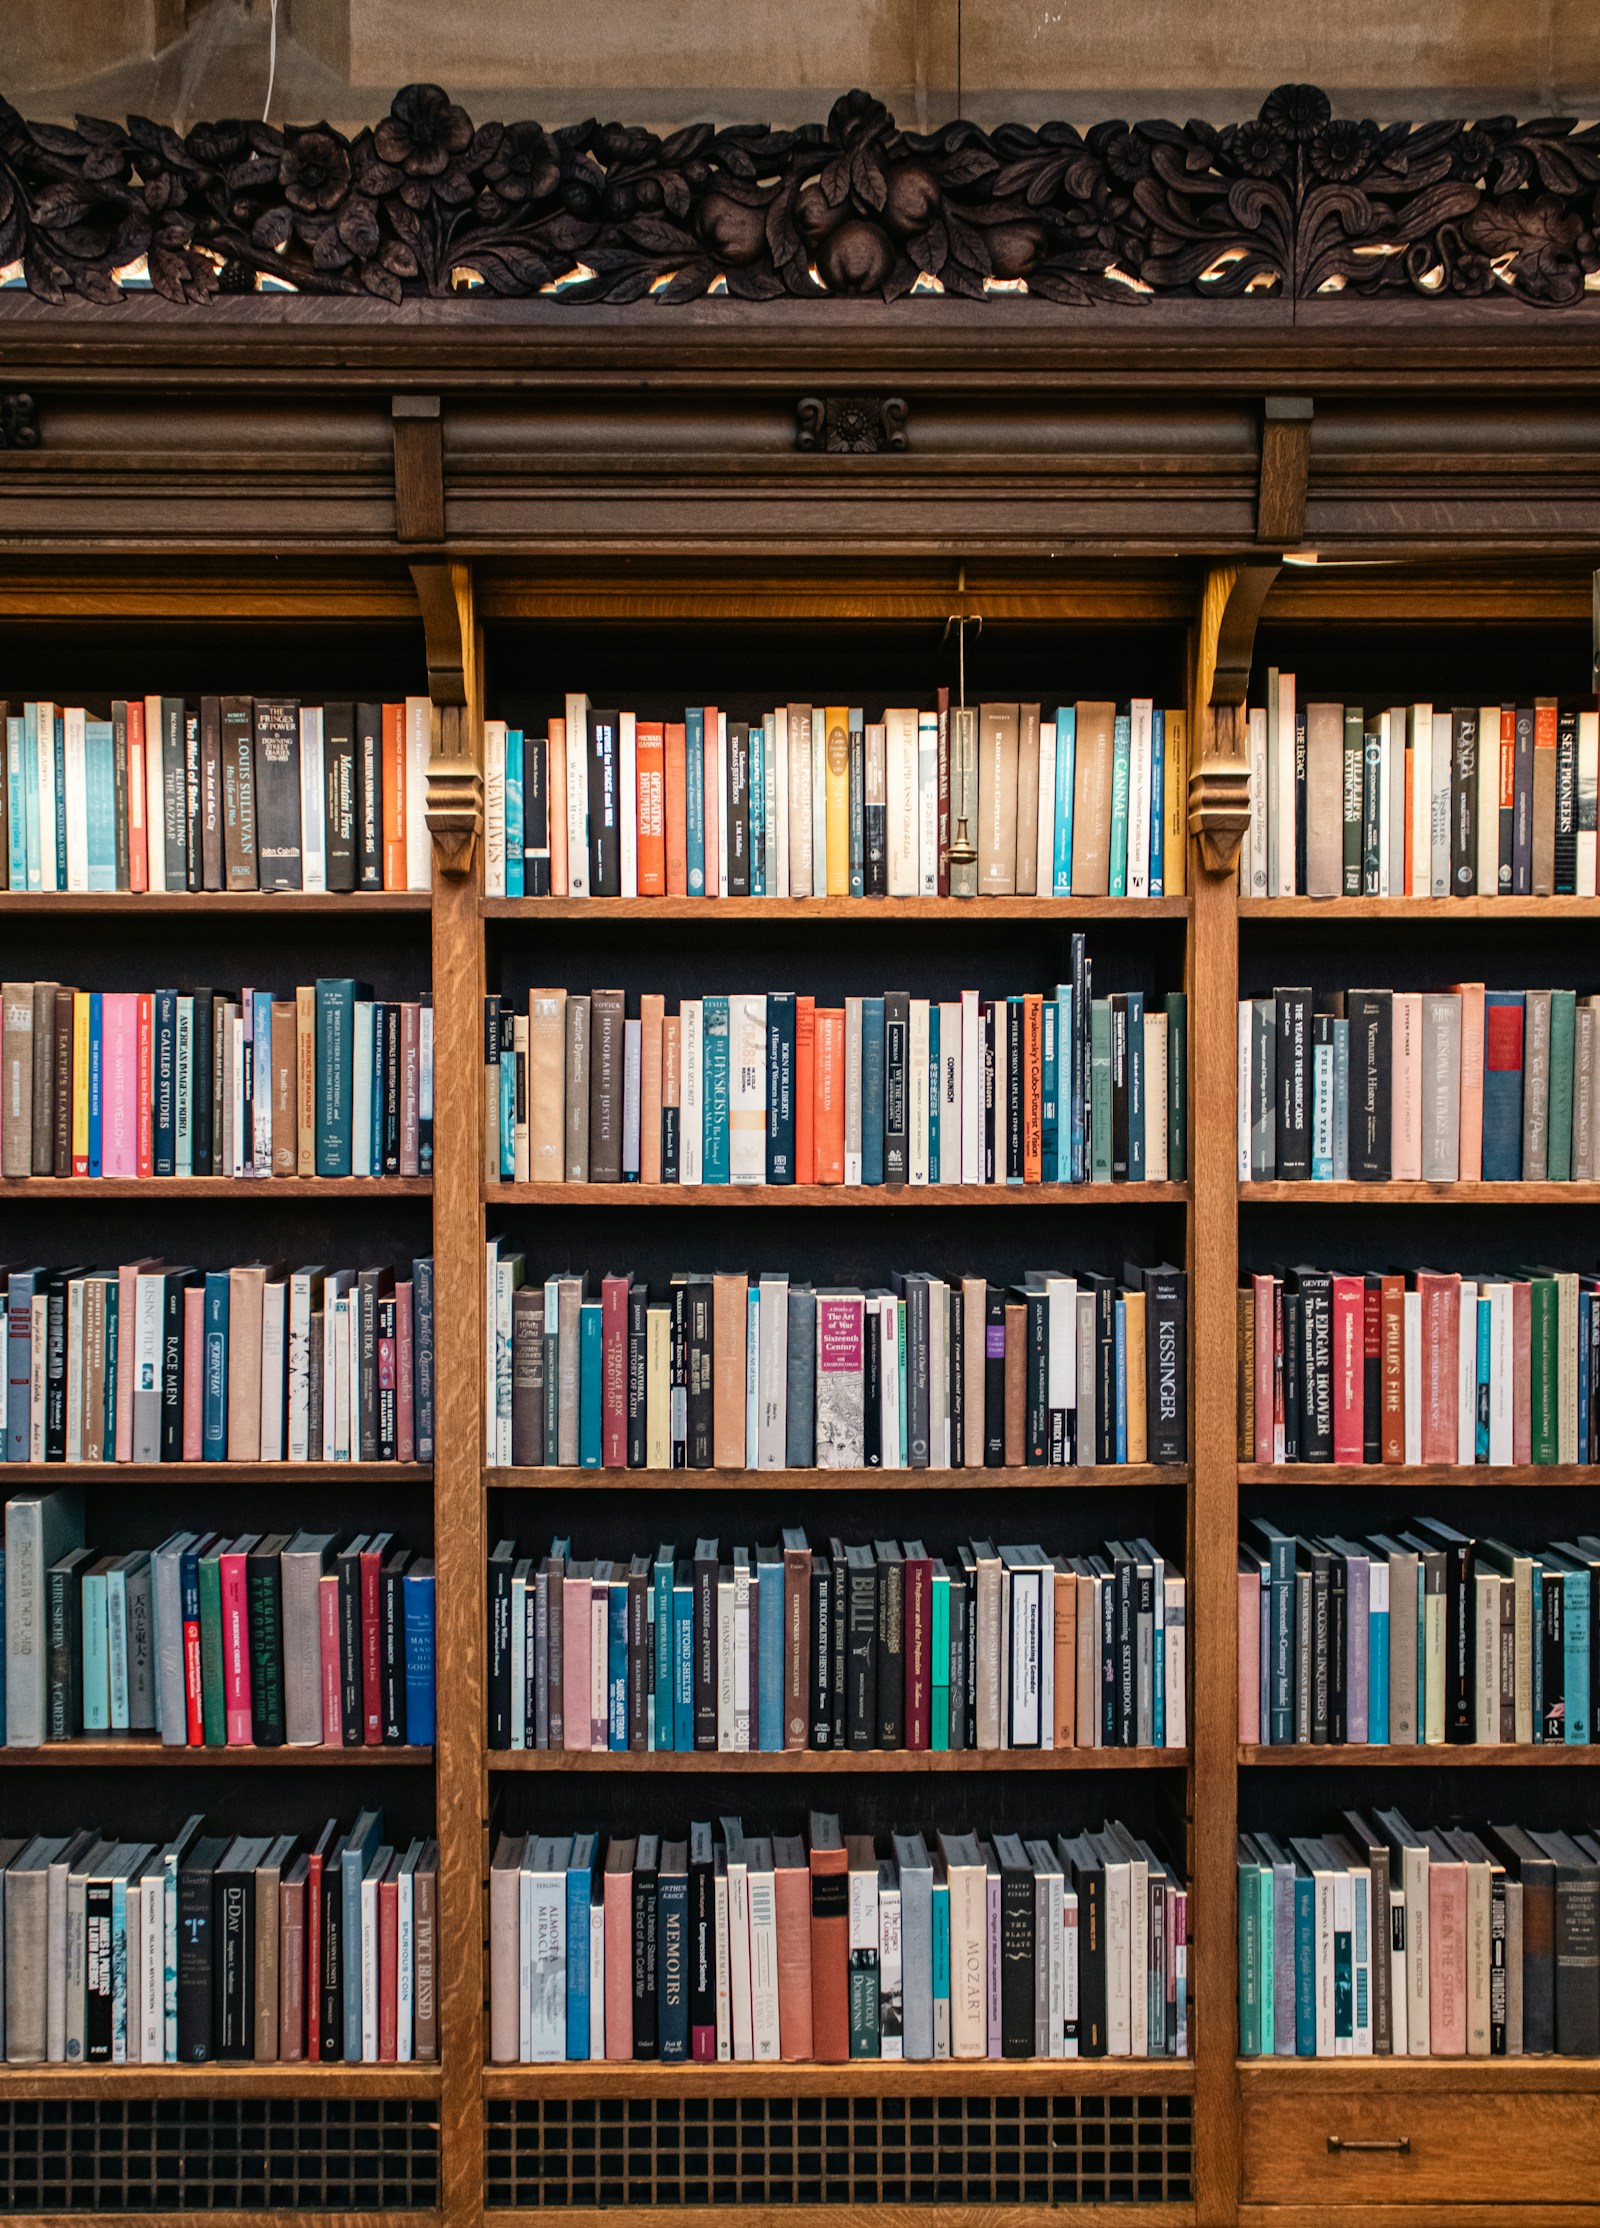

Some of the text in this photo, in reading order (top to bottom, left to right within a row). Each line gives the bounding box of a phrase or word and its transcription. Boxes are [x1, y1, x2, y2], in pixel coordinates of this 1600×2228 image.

[187, 718, 197, 739] The
[188, 741, 197, 769] Mind
[188, 771, 198, 783] of
[188, 786, 198, 817] Stalin
[238, 738, 252, 854] LOUIS SULLIVAN
[340, 754, 352, 839] Mountain Fires
[1114, 758, 1126, 818] CANNAE
[1255, 753, 1264, 799] Concerning
[1345, 750, 1353, 822] EXTINCTION
[1353, 750, 1362, 822] WILDLIFE
[1561, 733, 1572, 833] SETI PIONEERS
[166, 773, 175, 839] THE BAZAAR
[176, 768, 185, 846] REINVENTING
[206, 815, 215, 830] City
[489, 772, 502, 863] NEW LIVES
[640, 772, 650, 836] DRUMBEAT
[651, 772, 661, 836] OPERATION
[766, 800, 774, 810] &
[1255, 819, 1265, 854] Heritage
[1030, 1003, 1039, 1064] Mayakovsky's
[1295, 1003, 1303, 1021] THE
[59, 1036, 68, 1086] EARTH'S
[160, 1028, 170, 1078] GALILEO
[895, 1070, 902, 1082] WE
[1295, 1045, 1303, 1057] OF
[1365, 1022, 1378, 1112] Vietnam: A History
[160, 1081, 170, 1128] STUDIES
[600, 1018, 610, 1141] HONORABLE JUSTICE
[1295, 1077, 1303, 1129] BARRICADES
[364, 1283, 373, 1359] A BETTER IDEA
[1306, 1298, 1314, 1317] The
[1306, 1319, 1314, 1340] Man
[166, 1336, 178, 1405] RACE MEN
[826, 1344, 857, 1352] Century
[1159, 1321, 1175, 1421] KISSINGER
[1316, 1298, 1329, 1435] J. EDGAR HOOVER
[1387, 1314, 1400, 1412] APOLLO'S FIRE
[630, 1379, 637, 1390] OF
[1053, 1413, 1062, 1463] PATRICK TYLER
[52, 1575, 64, 1650] KHRUSHCHEV
[836, 1600, 844, 1612] OF
[851, 1577, 875, 1632] BULL!
[1121, 1600, 1130, 1641] Cumming
[1141, 1581, 1149, 1610] SEOUL
[819, 1646, 827, 1654] IN
[1277, 1586, 1288, 1706] Nineteenth-Century Music
[1123, 1645, 1131, 1715] SKETCHBOOK
[53, 1692, 64, 1735] CAREER
[637, 1931, 644, 1939] of
[852, 1877, 862, 1944] CONFIDENCE
[865, 1905, 874, 1916] IN
[1492, 1899, 1504, 1939] JOURNEYS
[418, 1917, 432, 2020] TWICE BLESSED
[667, 1913, 680, 2006] MEMOIRS
[967, 1940, 980, 2023] MOZART
[1492, 1968, 1504, 2024] ETHNOGRAPHY
